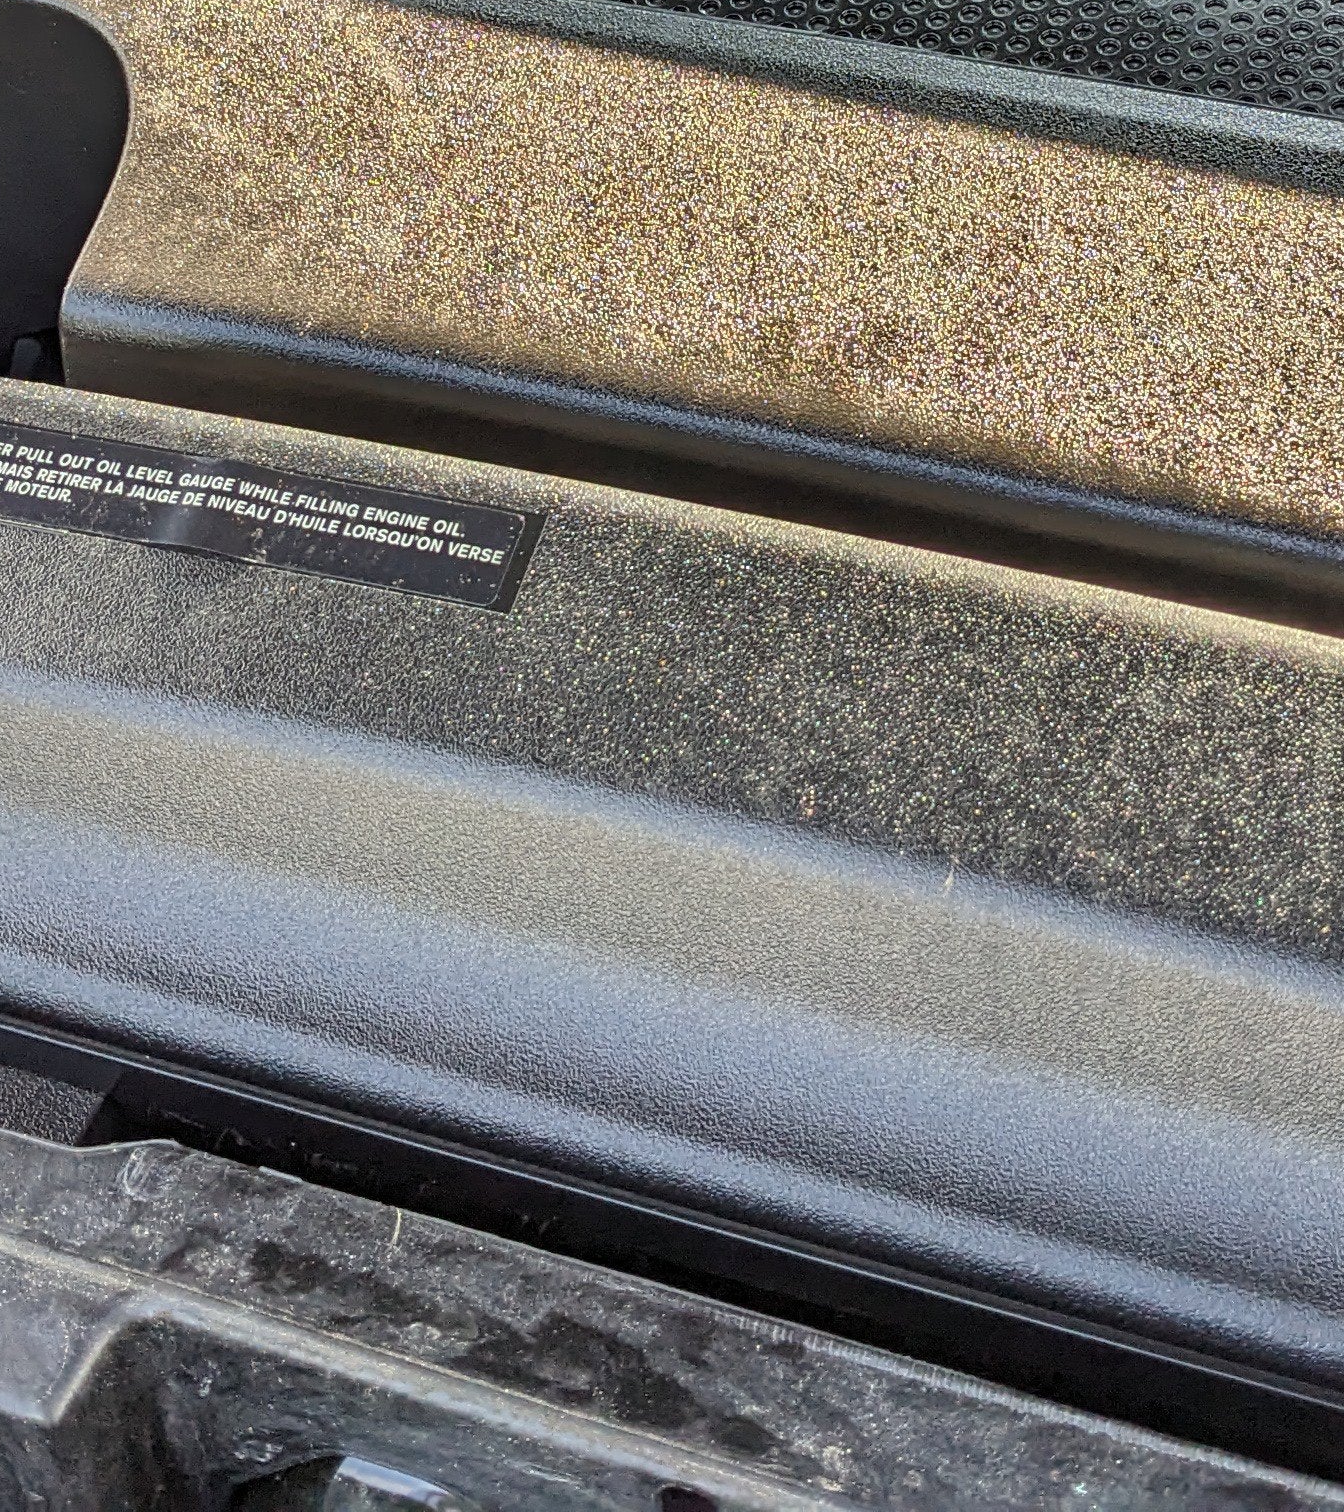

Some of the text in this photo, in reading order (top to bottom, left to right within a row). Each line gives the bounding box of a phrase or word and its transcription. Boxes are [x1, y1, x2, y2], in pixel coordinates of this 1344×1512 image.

[5, 478, 72, 503] MOTEUR.
[16, 445, 54, 464] PULL
[59, 453, 95, 471] OUT
[96, 460, 122, 476] OIL
[126, 464, 174, 485] LEVEL
[179, 473, 236, 492] GAUGE
[239, 480, 294, 505] WHILE
[294, 494, 360, 518] FILLING
[363, 506, 430, 531] ENGINE
[433, 519, 466, 538] OIL.
[36, 468, 103, 492] RETIRER
[105, 480, 124, 496] LA
[127, 485, 181, 505] JAUGE
[182, 491, 206, 507] DE
[207, 494, 271, 520] NIVEAU
[273, 509, 341, 534] D'HUILE
[343, 522, 444, 553] LORSQU'ON
[448, 541, 506, 565] VERSE
